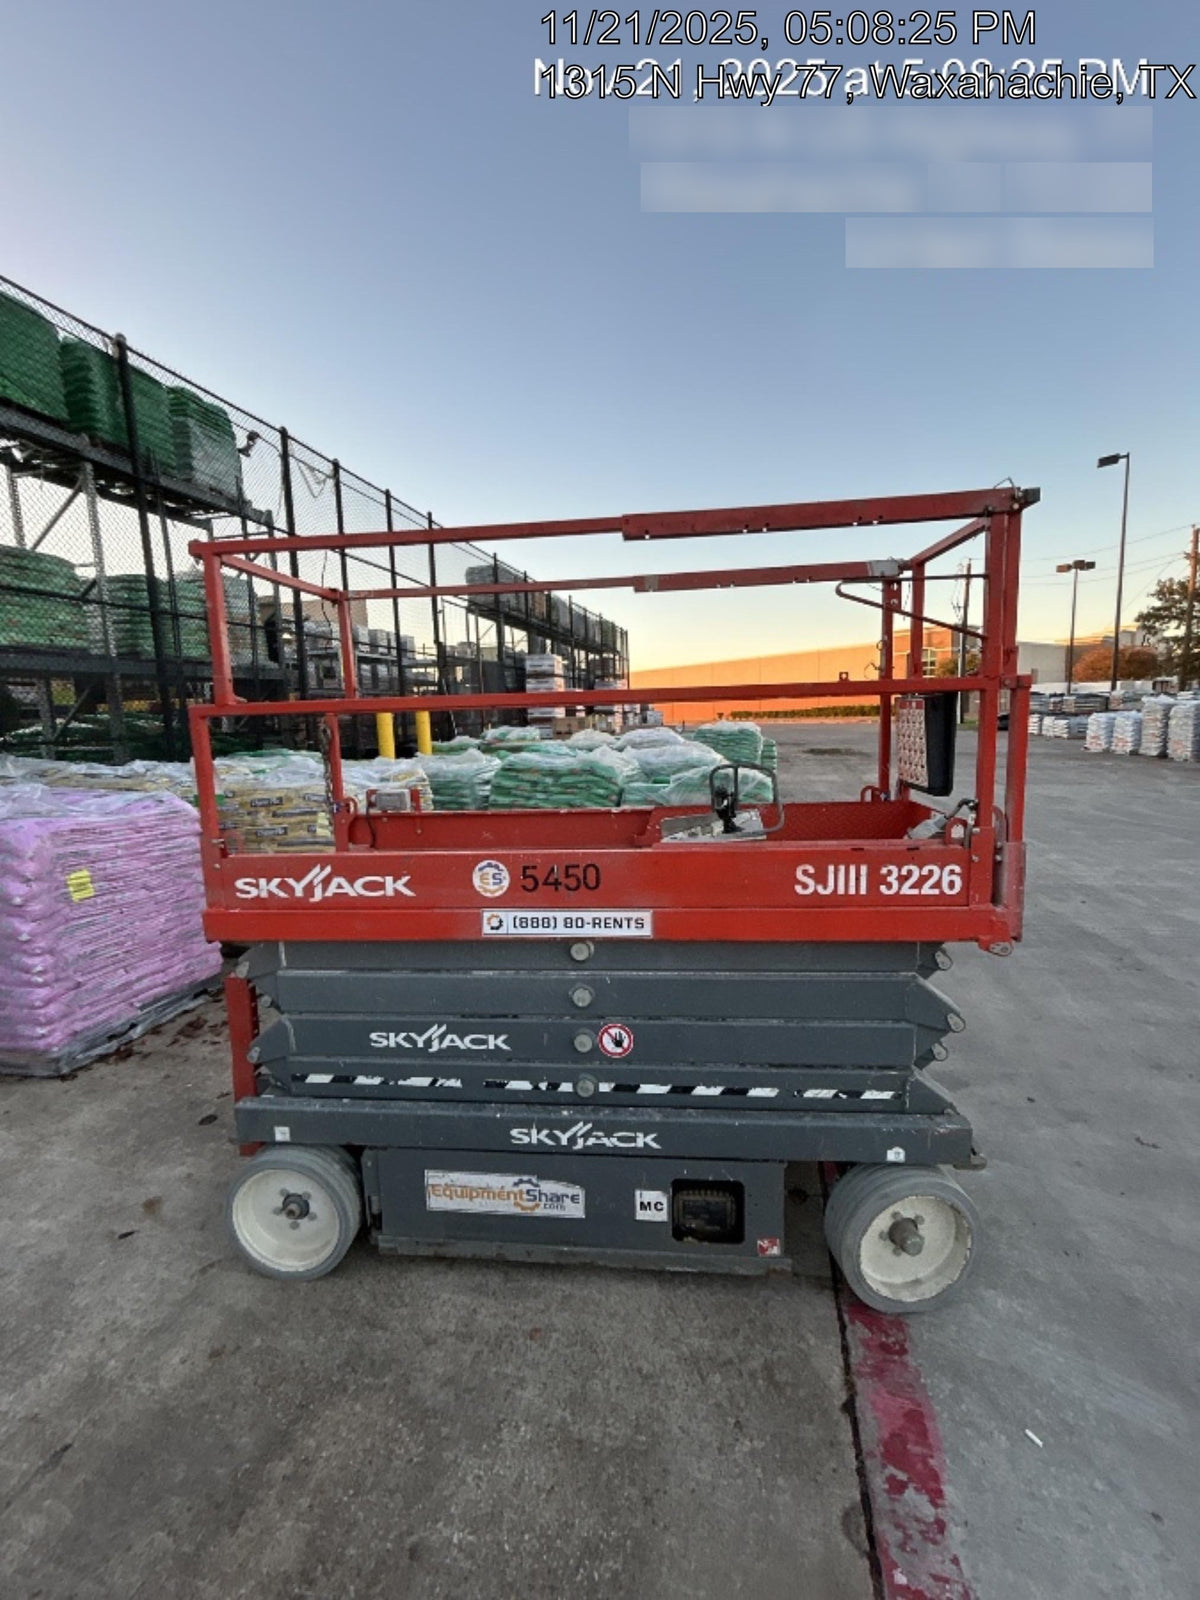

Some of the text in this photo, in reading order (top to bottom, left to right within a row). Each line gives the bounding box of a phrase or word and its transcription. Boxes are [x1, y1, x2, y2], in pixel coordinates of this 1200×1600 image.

[235, 863, 416, 902] SKYJACK
[521, 863, 600, 893] 5450
[795, 863, 962, 895] SJIII 3226
[513, 915, 645, 930] (888) 80-RENTS
[369, 1023, 511, 1053] SKYJACK
[510, 1121, 661, 1150] SKYJACK
[639, 1201, 664, 1212] MC
